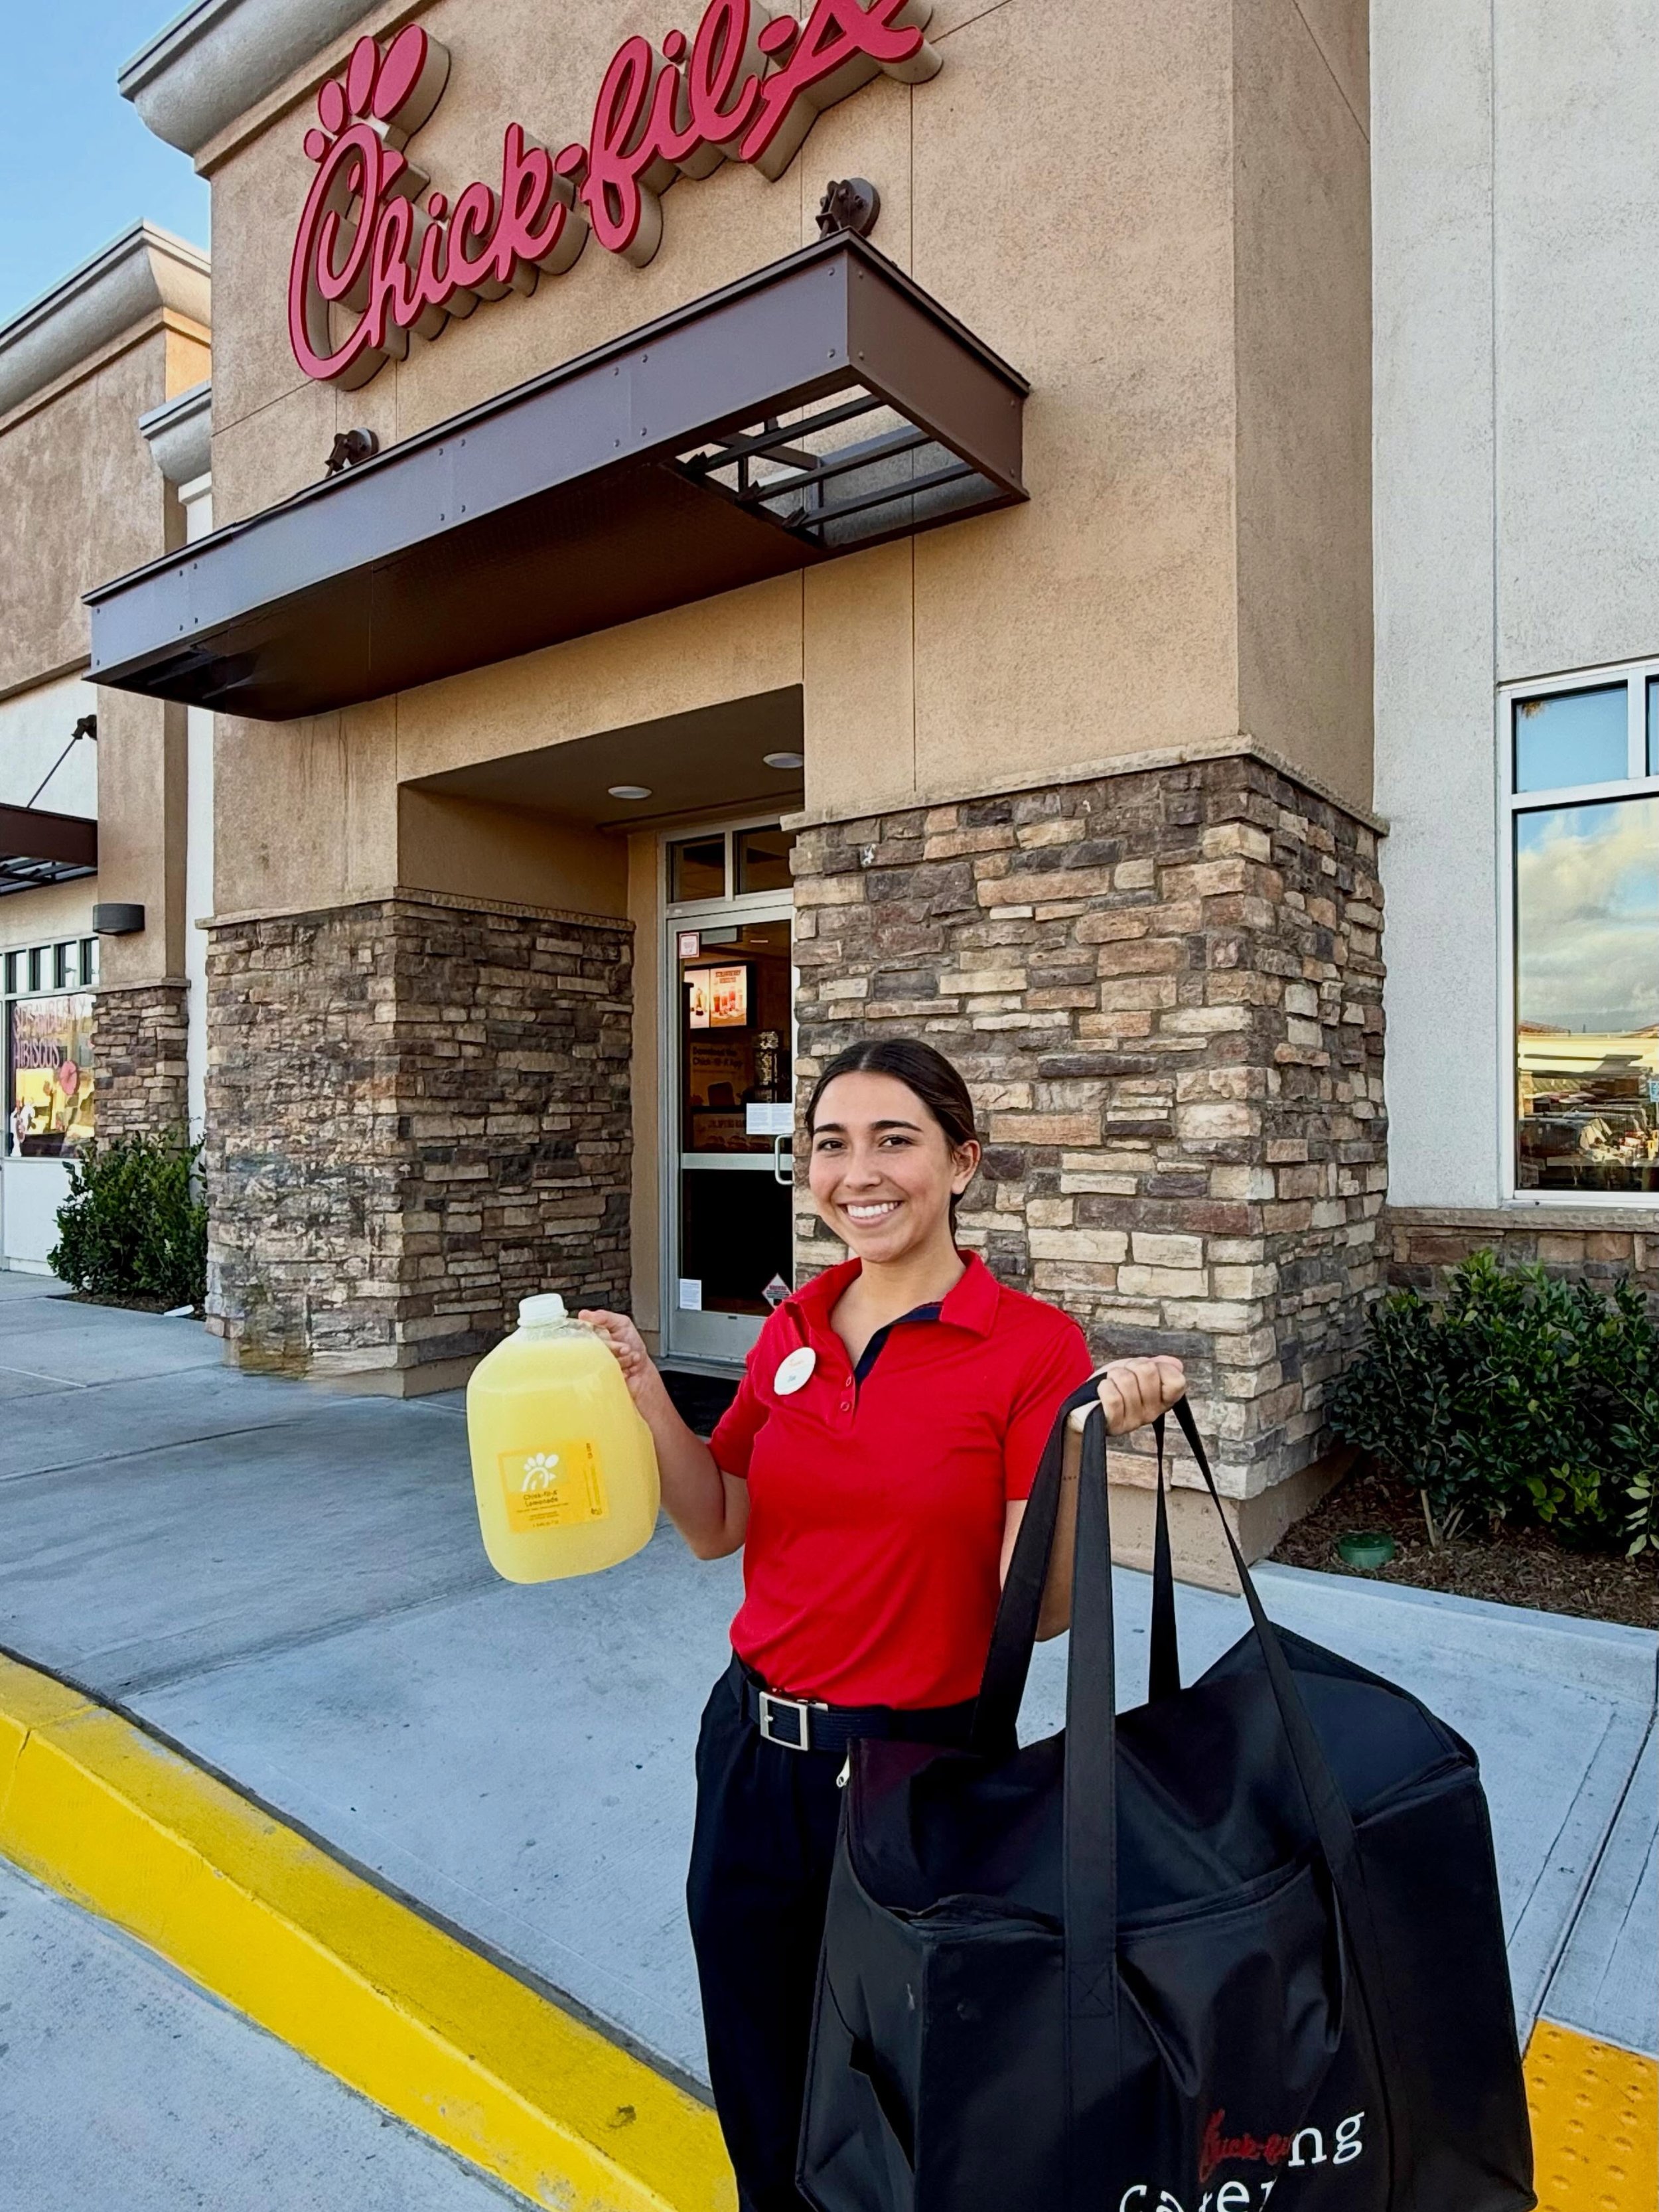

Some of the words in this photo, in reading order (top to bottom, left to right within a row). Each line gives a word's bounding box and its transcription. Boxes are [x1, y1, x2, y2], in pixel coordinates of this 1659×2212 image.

[288, 0, 924, 380] Chick-fil-A
[13, 1037, 60, 1069] HIBISCUS
[524, 1497, 559, 1507] Lemonade
